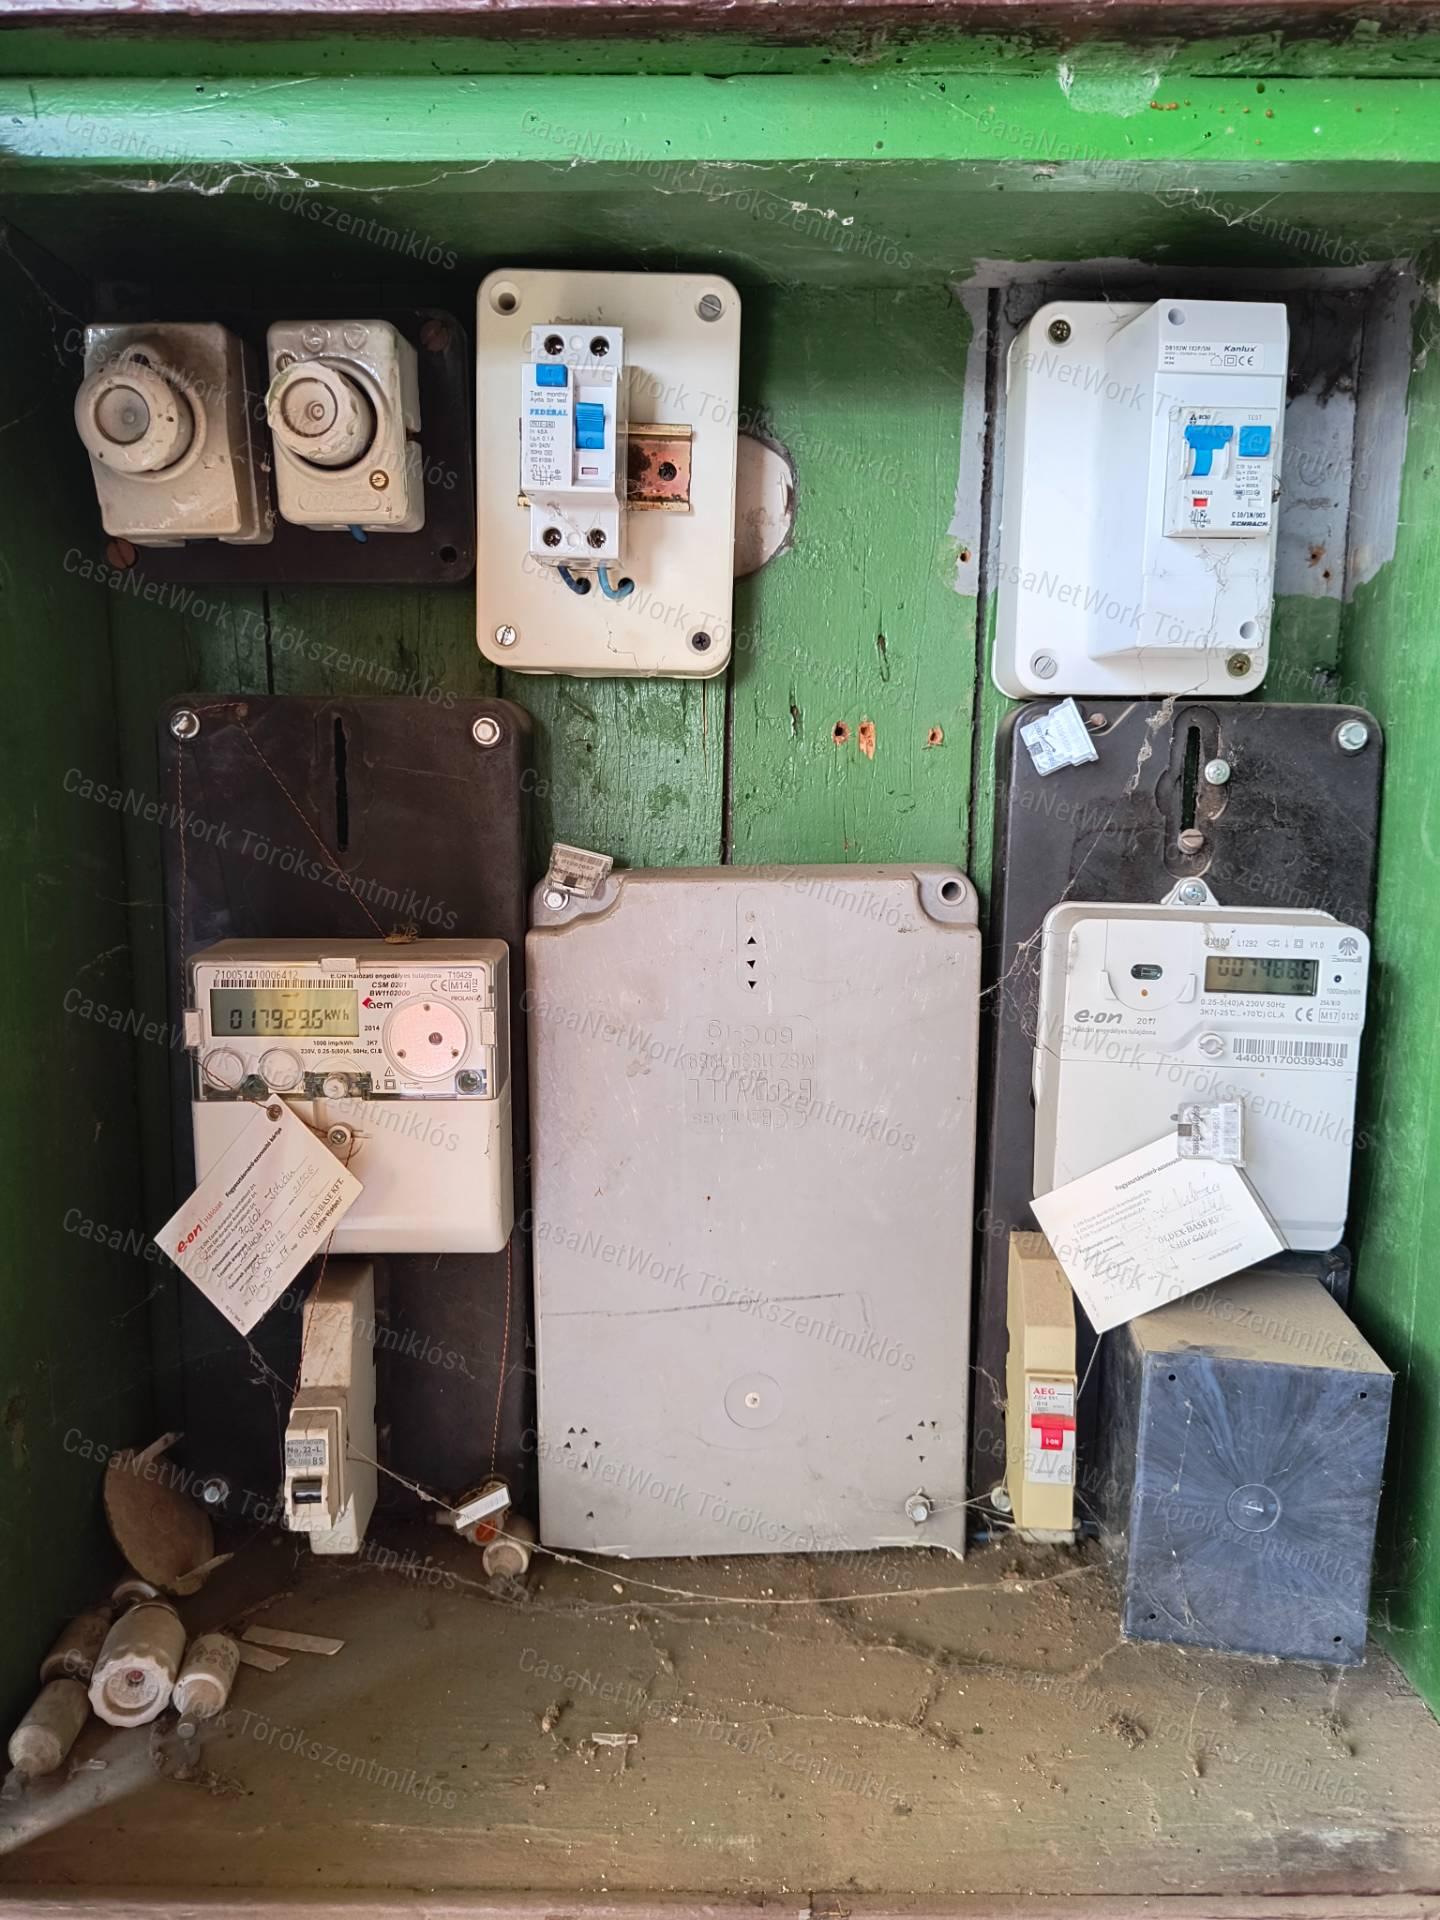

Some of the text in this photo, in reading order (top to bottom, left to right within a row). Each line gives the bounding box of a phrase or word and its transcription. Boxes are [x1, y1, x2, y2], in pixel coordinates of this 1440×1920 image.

[1223, 344, 1256, 353] Kanlux
[529, 408, 568, 416] FEDERAL
[371, 981, 389, 989] CSM
[450, 982, 470, 990] M14
[368, 1001, 394, 1009] aem
[1245, 1000, 1265, 1008] 230V
[1266, 1001, 1286, 1009] 50Hz
[1320, 1010, 1339, 1021] M17
[1341, 1011, 1359, 1021] 0120
[1235, 1055, 1345, 1067] 440011700393438
[1033, 1387, 1056, 1395] AEG
